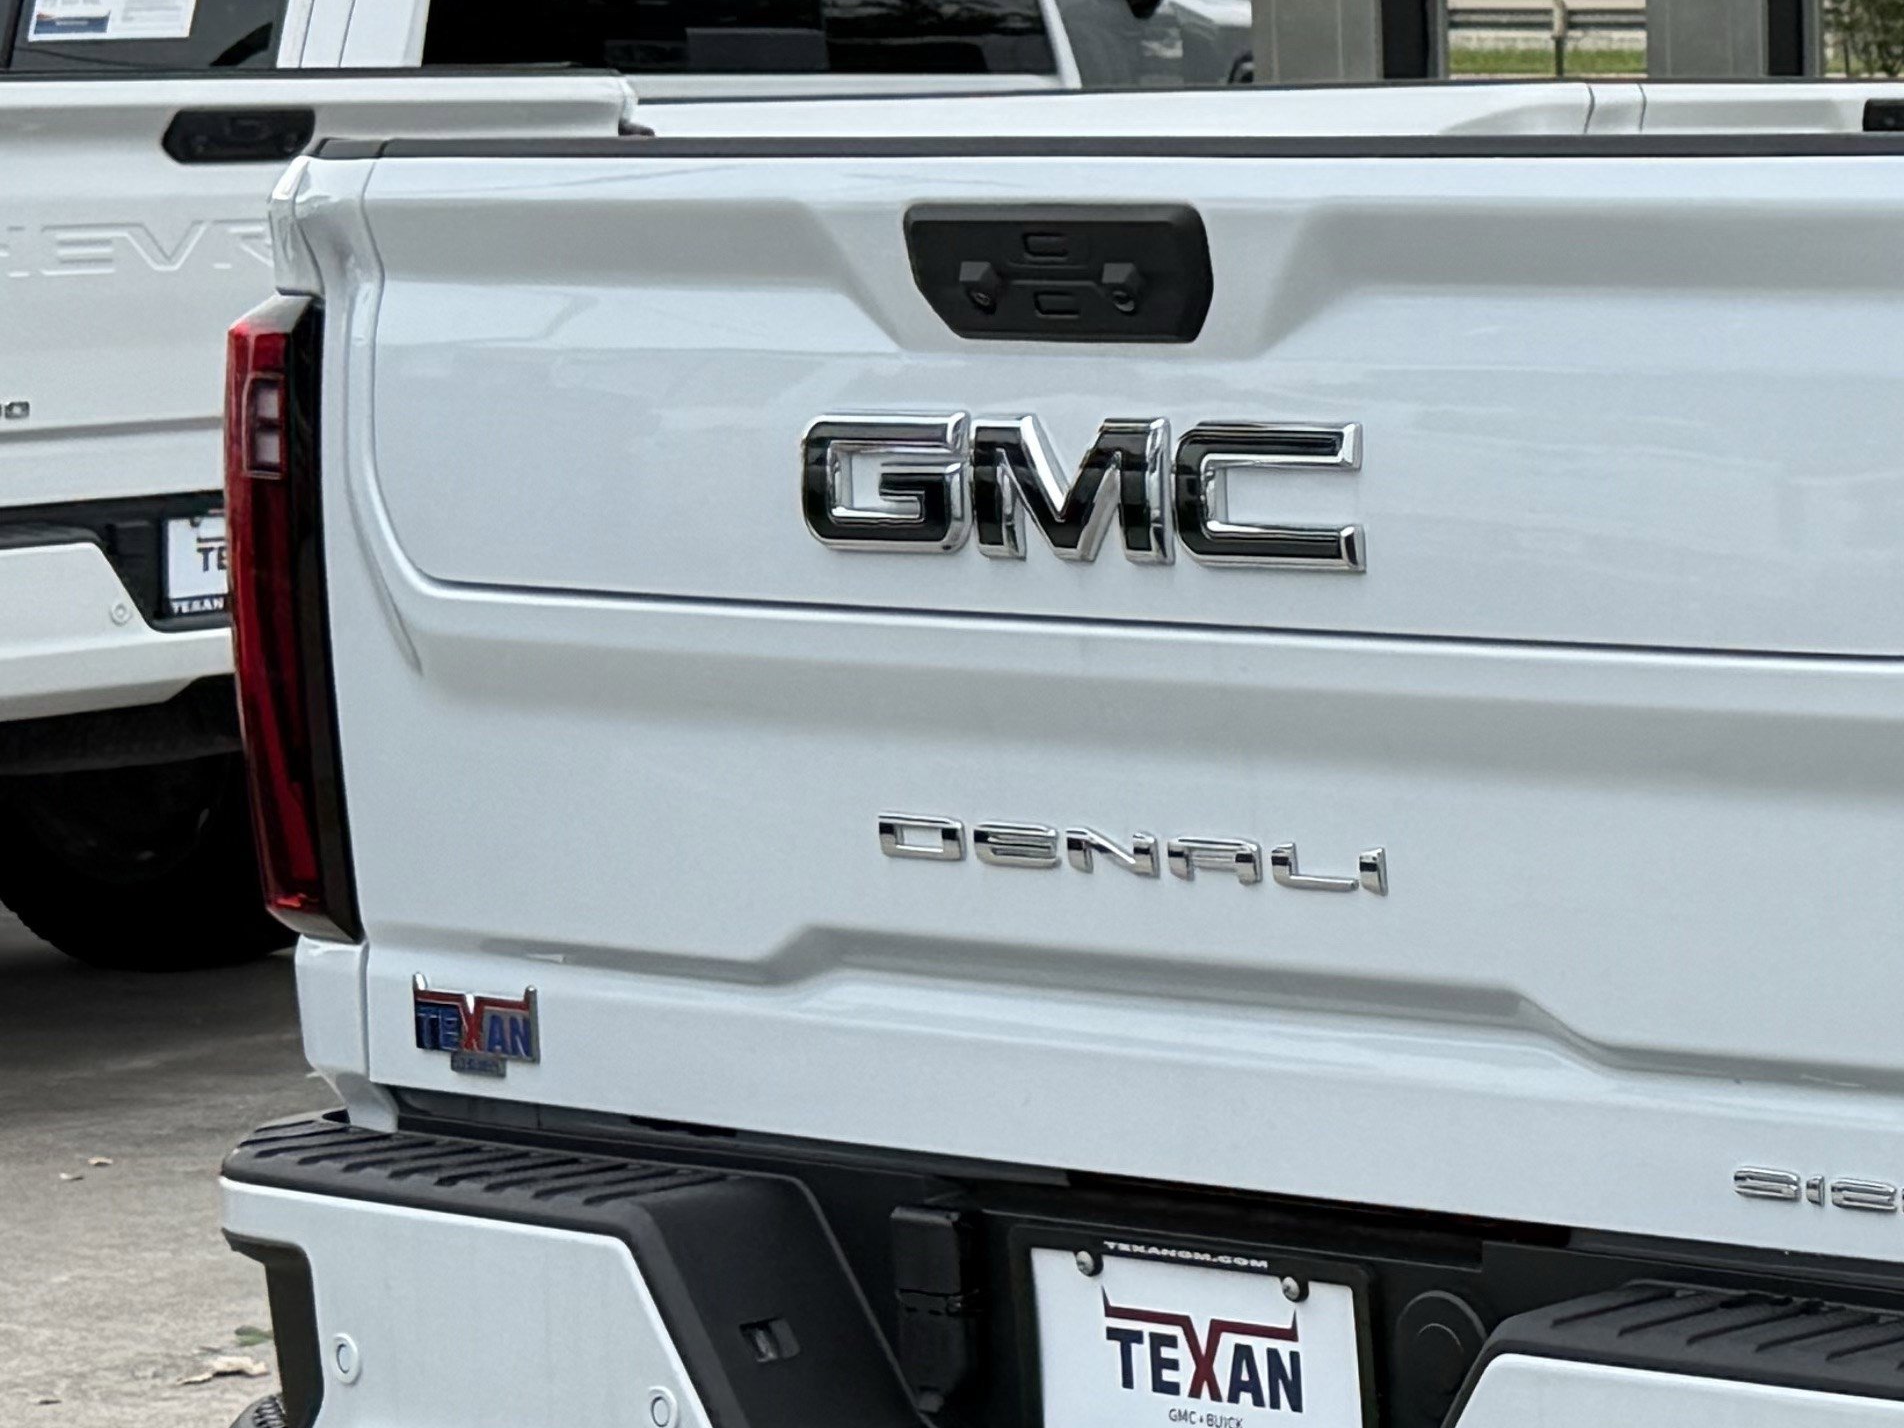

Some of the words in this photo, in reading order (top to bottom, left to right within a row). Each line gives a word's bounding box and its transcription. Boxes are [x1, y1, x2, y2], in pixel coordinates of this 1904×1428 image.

[801, 410, 1366, 573] GMC
[878, 812, 1389, 896] DENALI
[413, 982, 537, 1061] TEXAN
[1101, 1285, 1303, 1413] TEXAN
[1168, 1408, 1197, 1425] GMC
